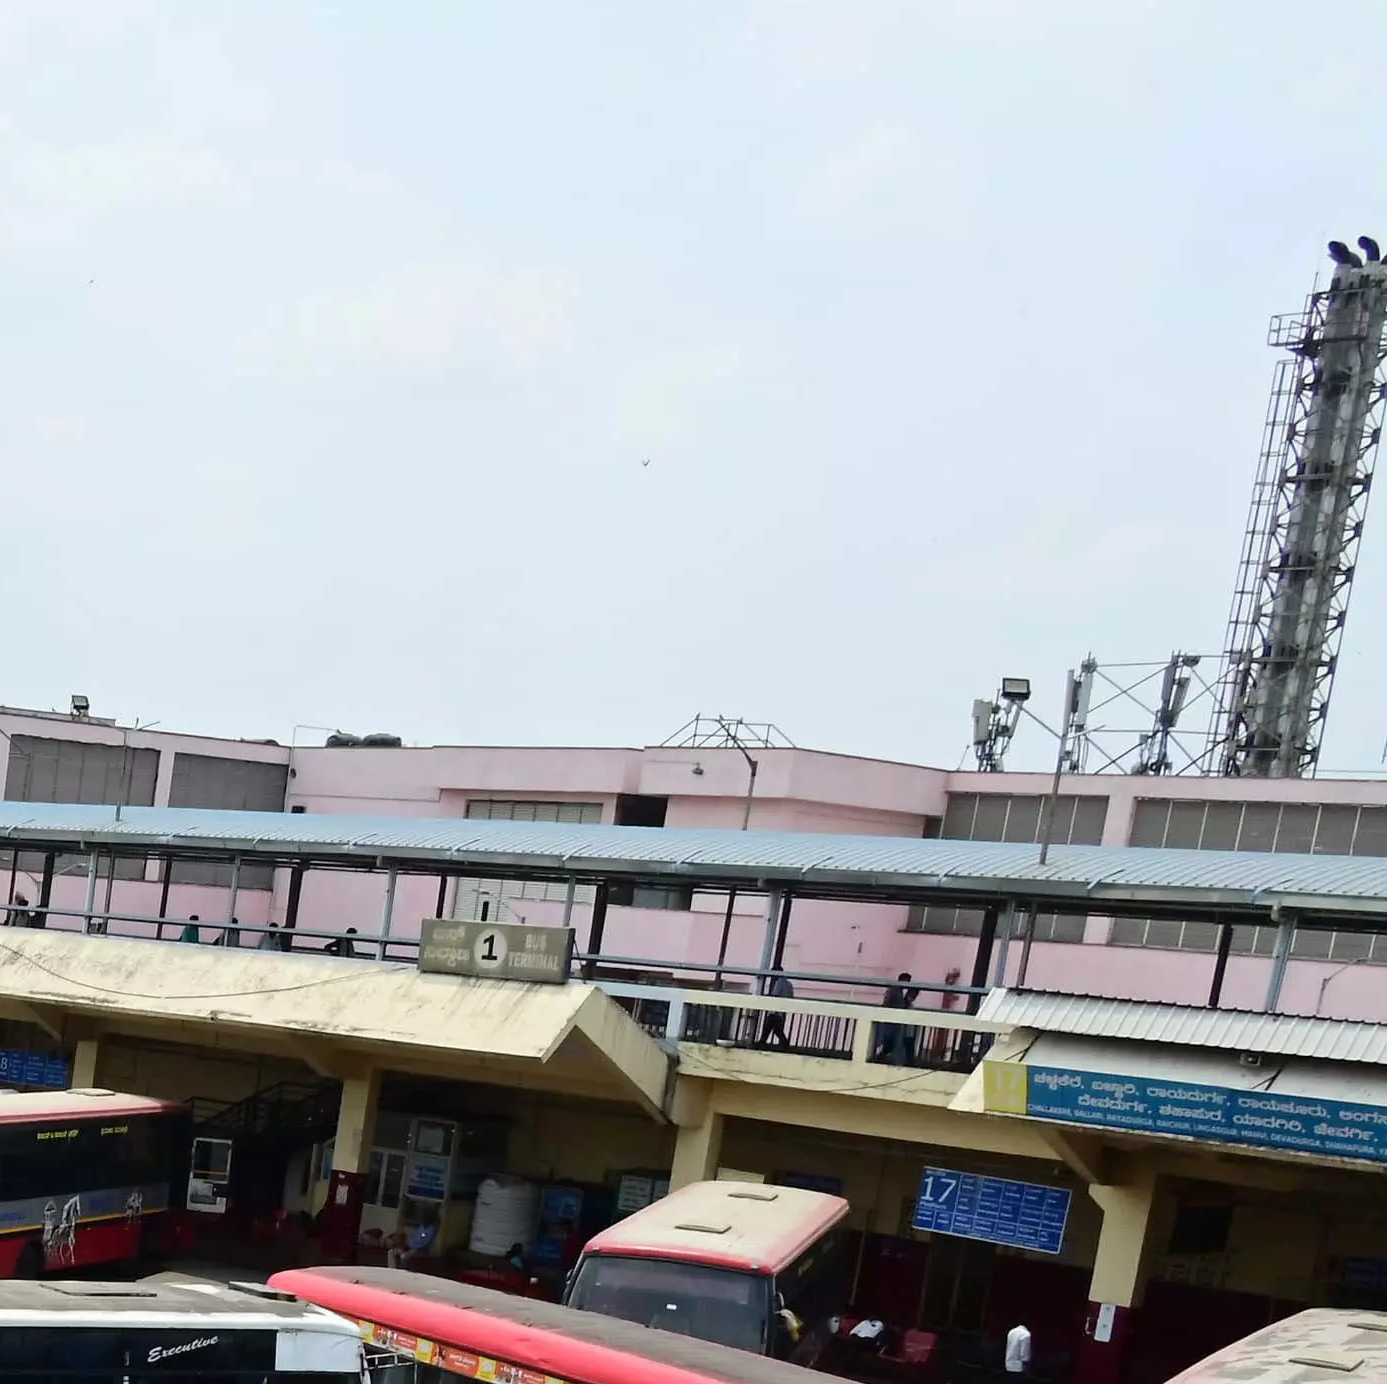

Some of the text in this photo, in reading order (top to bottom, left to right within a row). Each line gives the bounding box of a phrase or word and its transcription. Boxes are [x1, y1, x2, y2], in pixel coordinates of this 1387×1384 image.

[481, 934, 497, 961] 1
[526, 934, 547, 950] BUS
[509, 951, 559, 971] TERMINAL
[921, 1176, 957, 1203] 17
[147, 1336, 219, 1363] Executive
